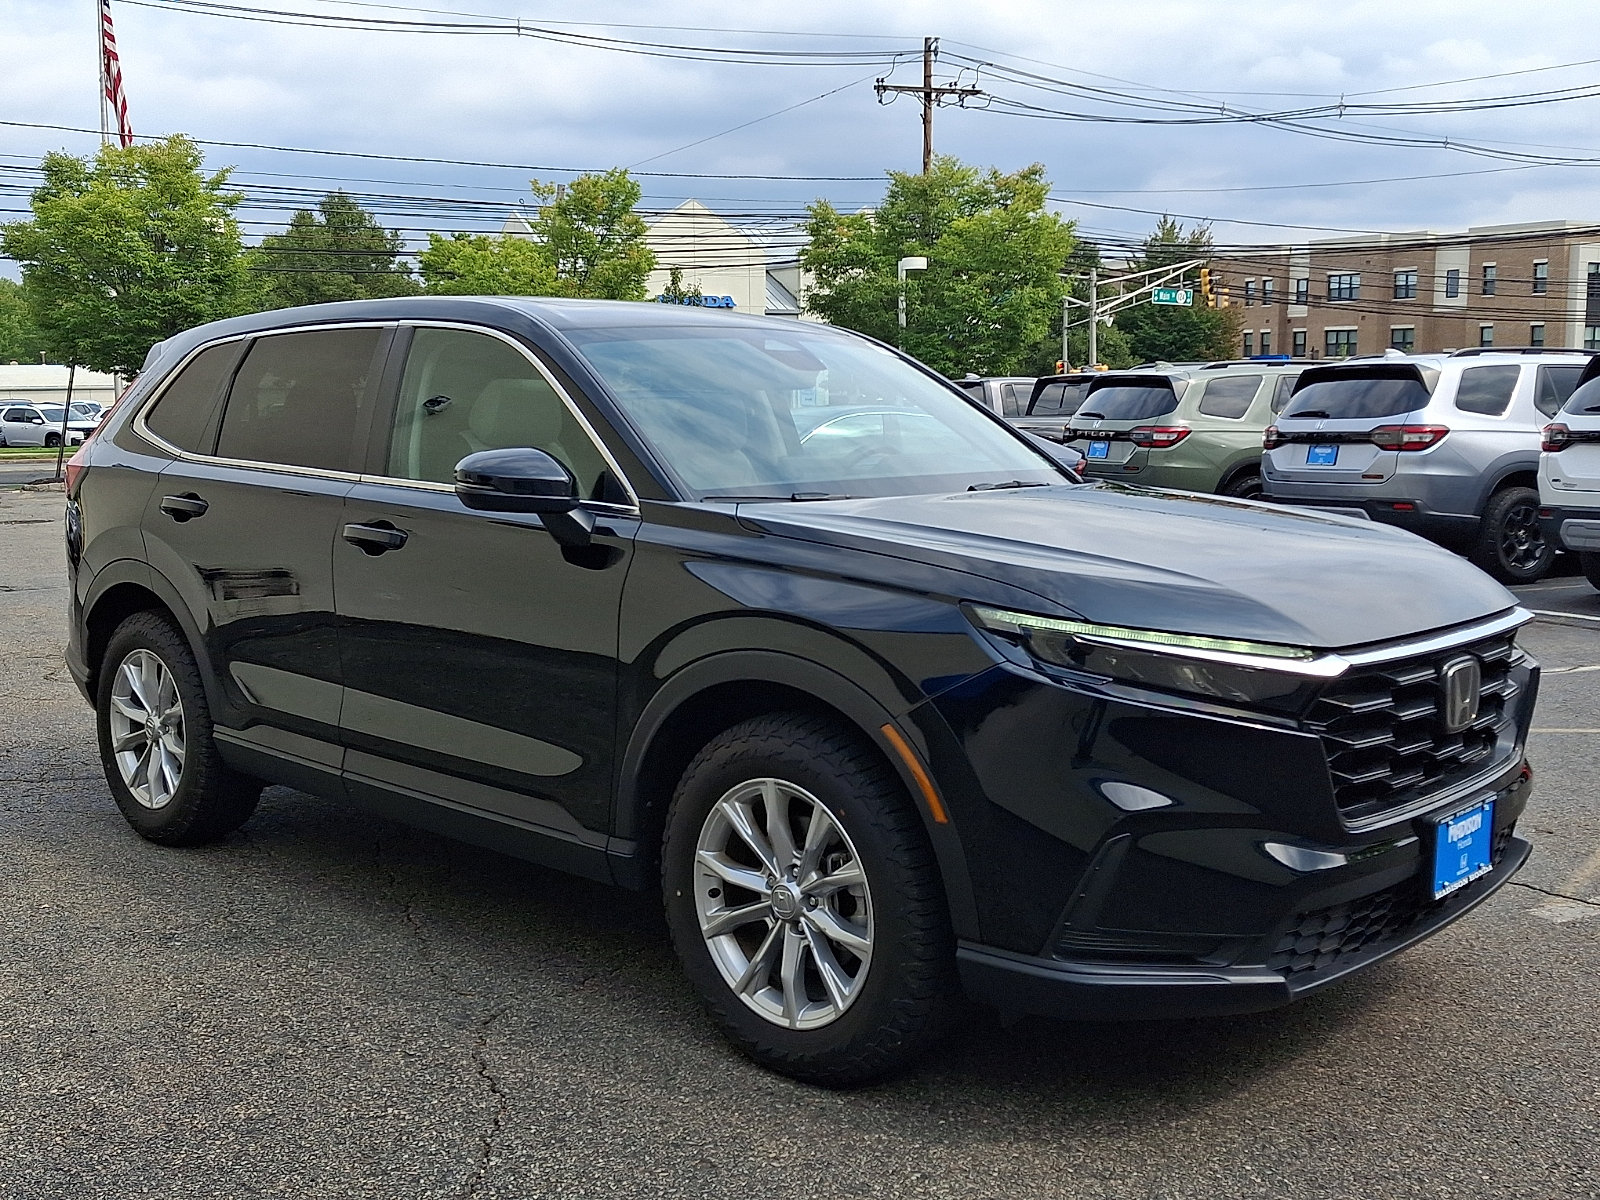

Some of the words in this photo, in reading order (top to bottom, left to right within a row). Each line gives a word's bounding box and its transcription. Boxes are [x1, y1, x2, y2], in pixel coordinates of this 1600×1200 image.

[1159, 292, 1170, 300] Main
[1435, 877, 1469, 900] MADISON
[1469, 864, 1494, 882] HONDA
